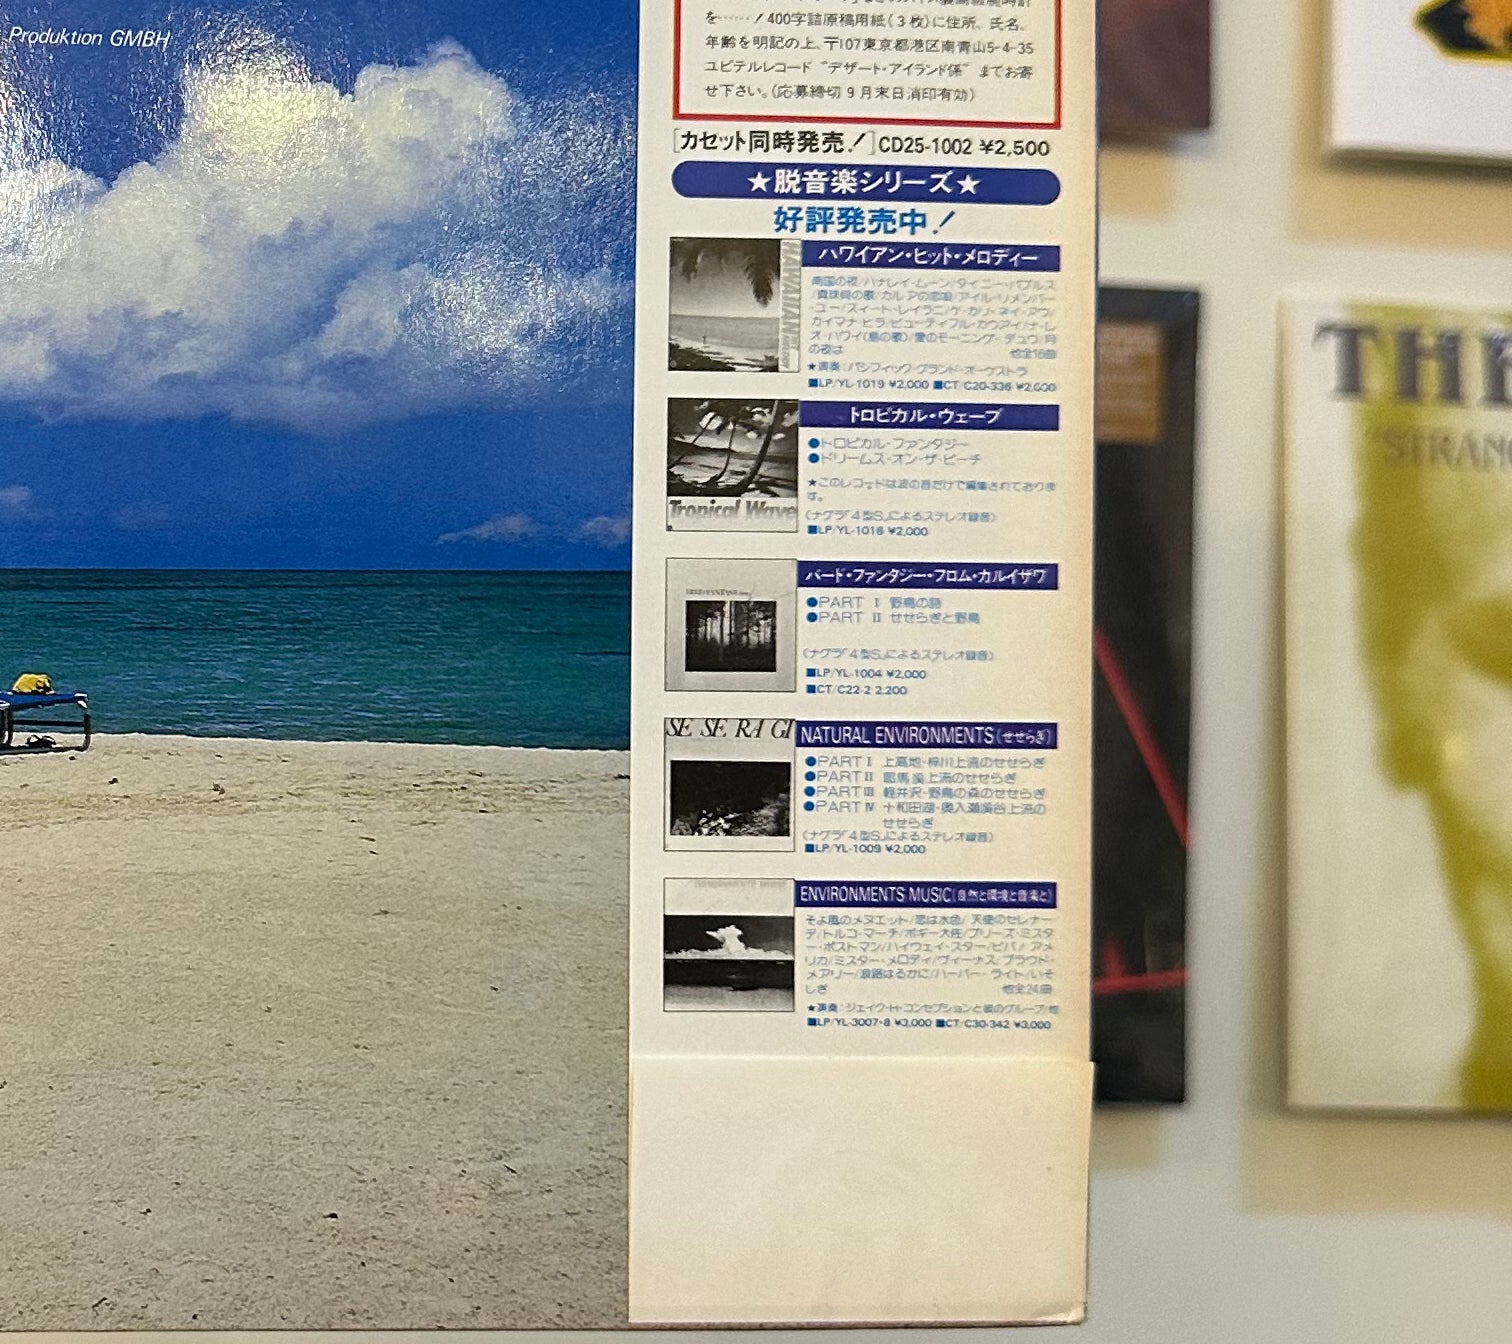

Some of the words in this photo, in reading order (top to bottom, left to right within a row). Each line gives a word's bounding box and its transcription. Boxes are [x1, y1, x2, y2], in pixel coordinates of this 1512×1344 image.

[9, 26, 103, 47] Produktion
[110, 30, 171, 49] GMBH
[878, 136, 973, 156] CD25-1002
[979, 138, 1050, 157] ¥2,500
[819, 245, 1038, 268] ハワイアン・ヒット・メロディー
[800, 725, 870, 744] NATURAL
[874, 726, 994, 744] ENVIRONMENTS
[800, 885, 905, 903] ENVIRONMENTS
[908, 886, 952, 904] MUSIC
